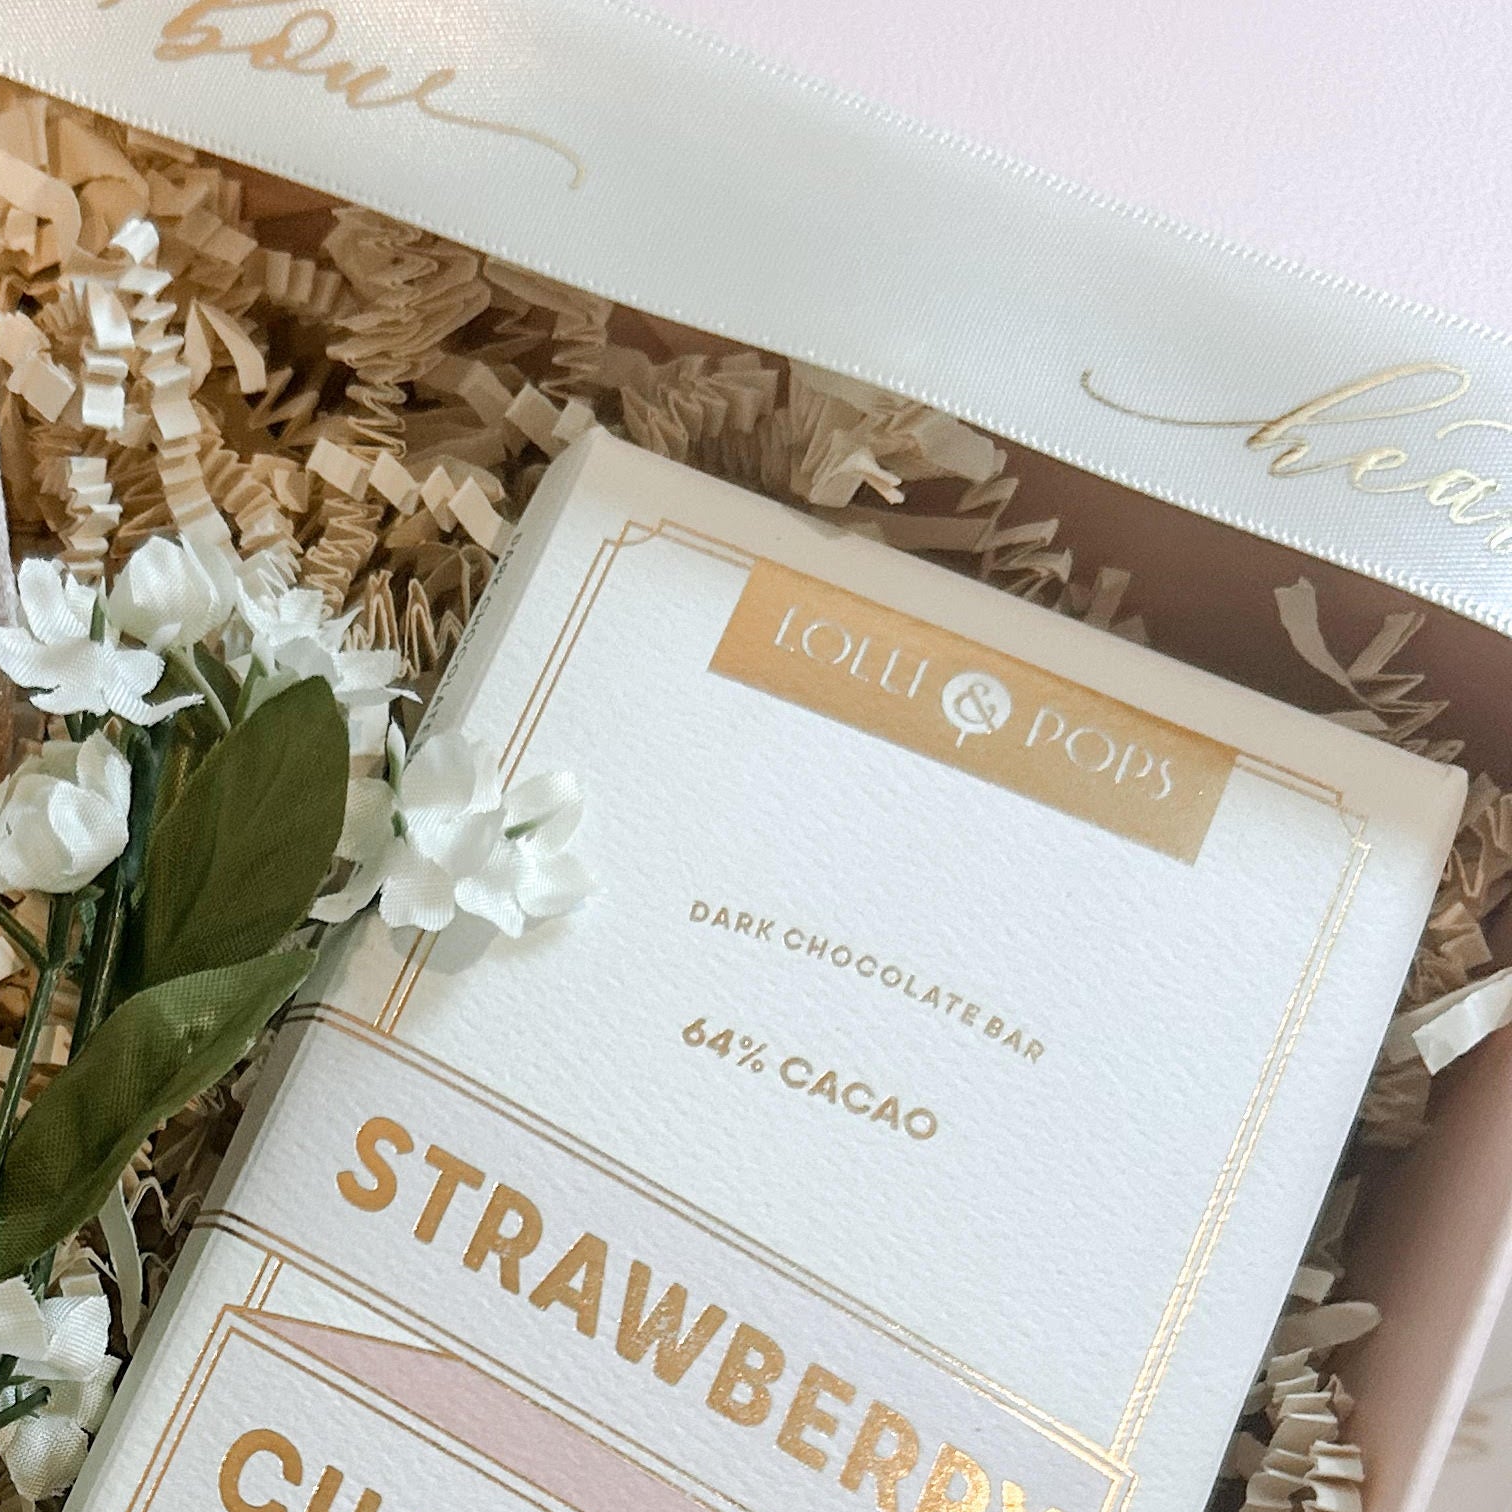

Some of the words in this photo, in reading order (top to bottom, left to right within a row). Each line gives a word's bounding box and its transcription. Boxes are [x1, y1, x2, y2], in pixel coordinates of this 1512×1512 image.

[1080, 360, 1512, 556] hea
[773, 606, 928, 699] LOLLI
[1025, 705, 1174, 800] POPS
[689, 900, 775, 942] DARK
[782, 927, 982, 1028] CHOCOLATE
[983, 1015, 1046, 1064] BAR
[681, 1018, 768, 1074] 64%
[779, 1056, 939, 1141] CACAO
